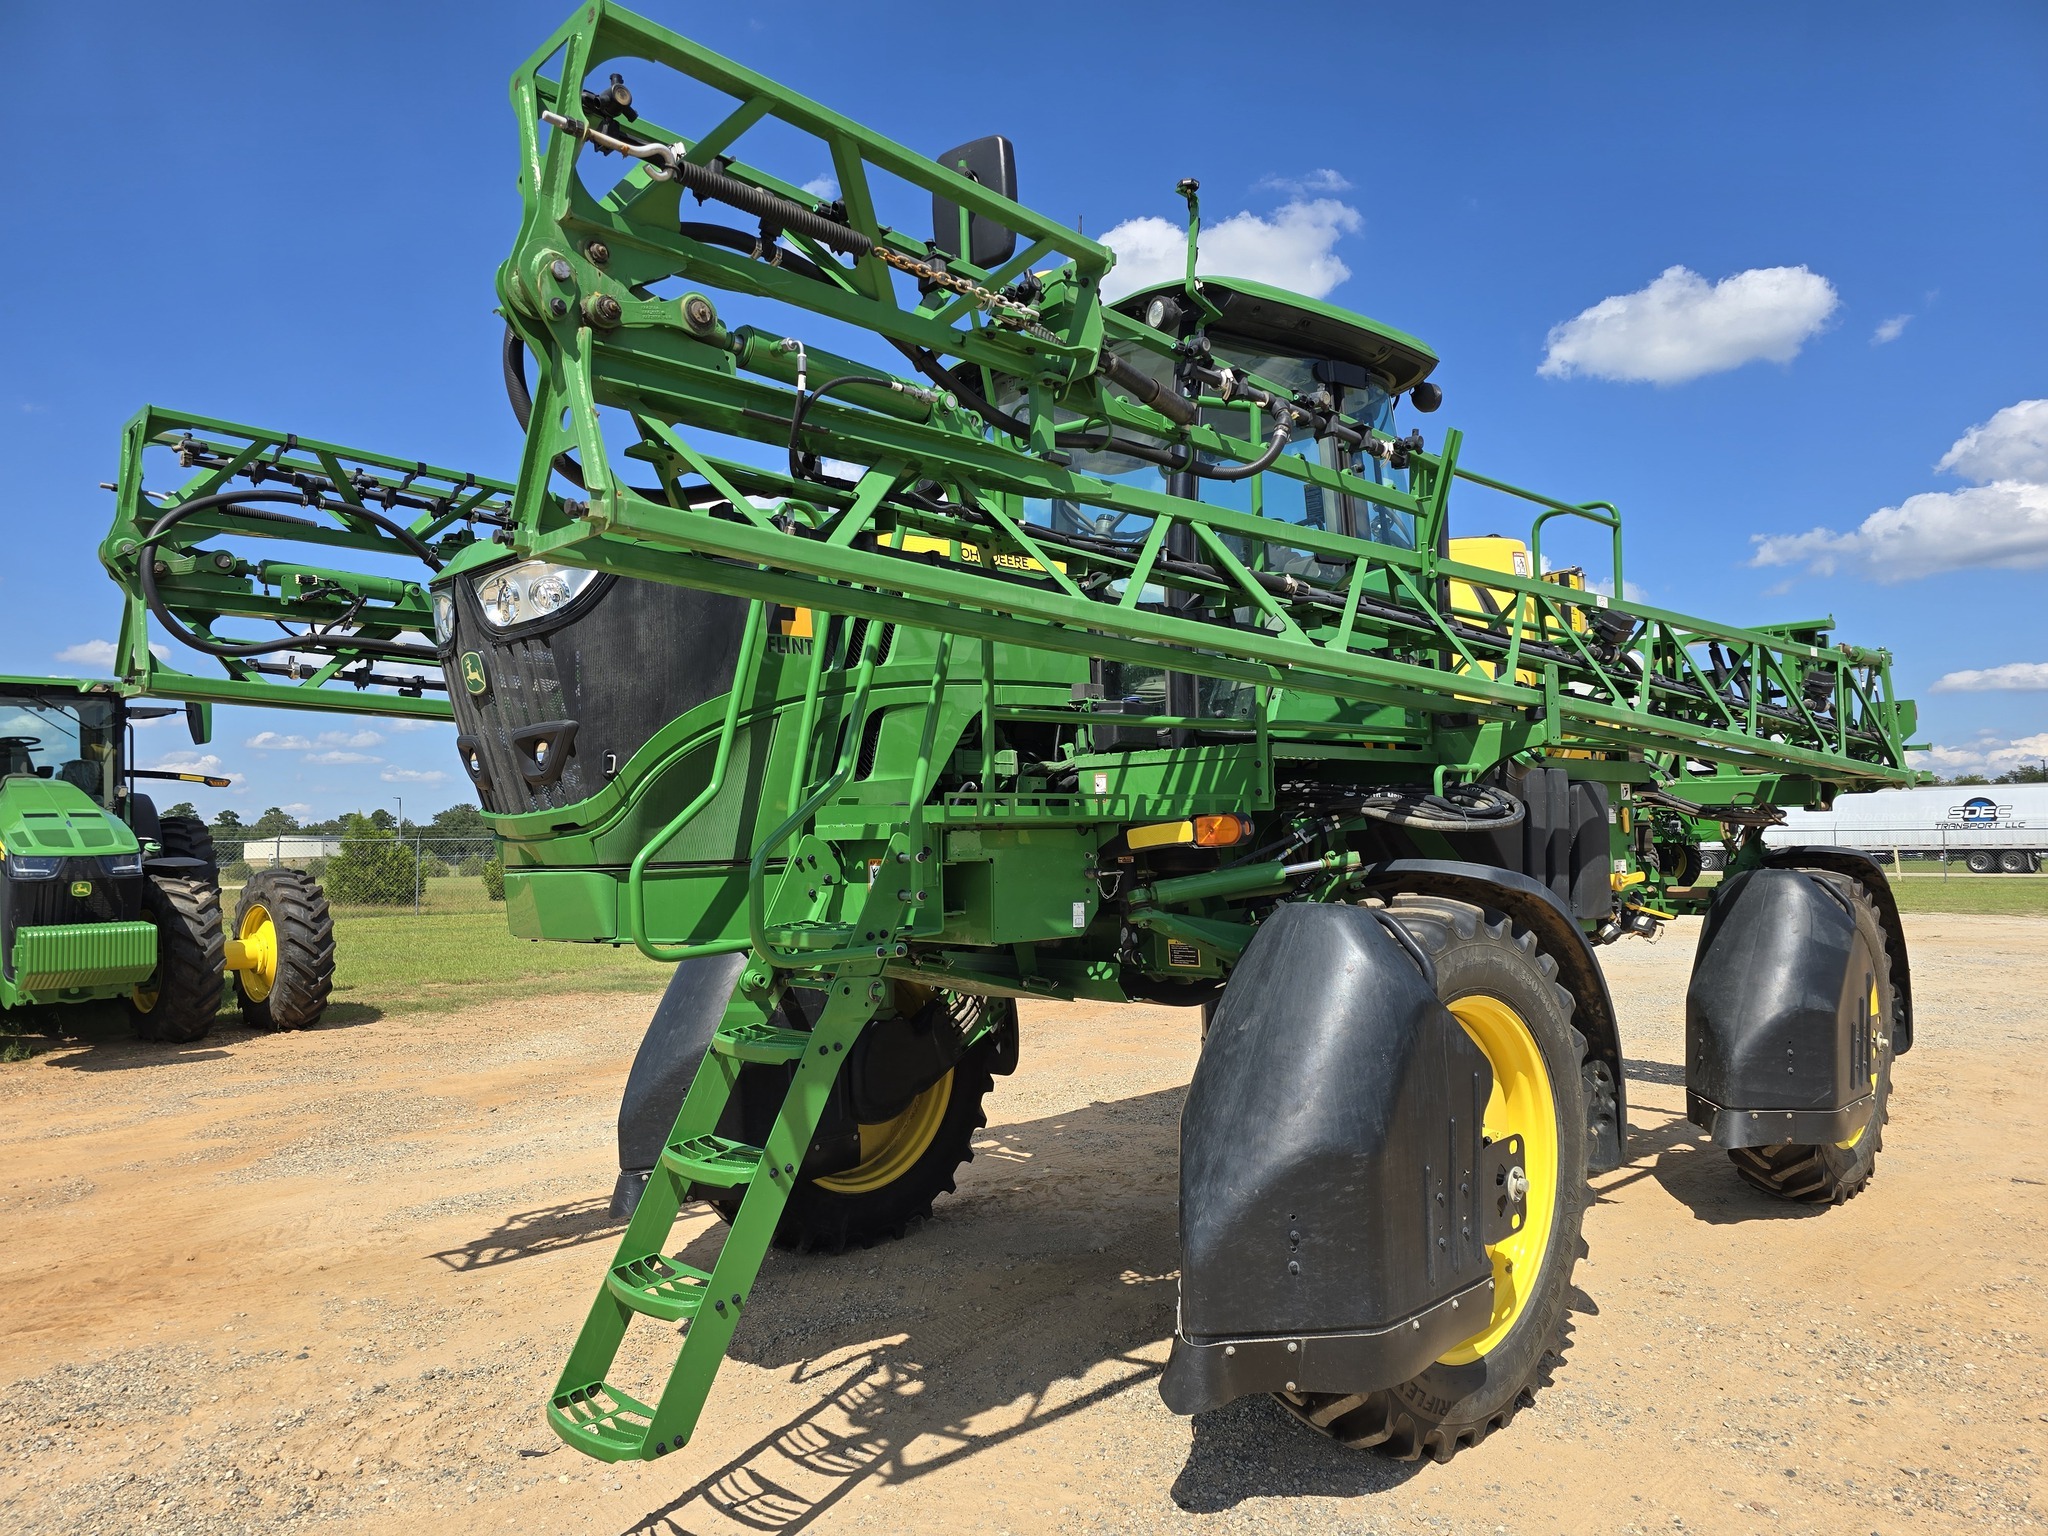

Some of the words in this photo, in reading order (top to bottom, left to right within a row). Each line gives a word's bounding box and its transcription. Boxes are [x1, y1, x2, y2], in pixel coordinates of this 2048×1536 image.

[994, 554, 1030, 569] DEERE
[767, 635, 814, 656] FLINT
[1947, 804, 2014, 820] SDEC
[1935, 822, 2001, 830] TRANSPORT
[2005, 821, 2027, 829] LLC
